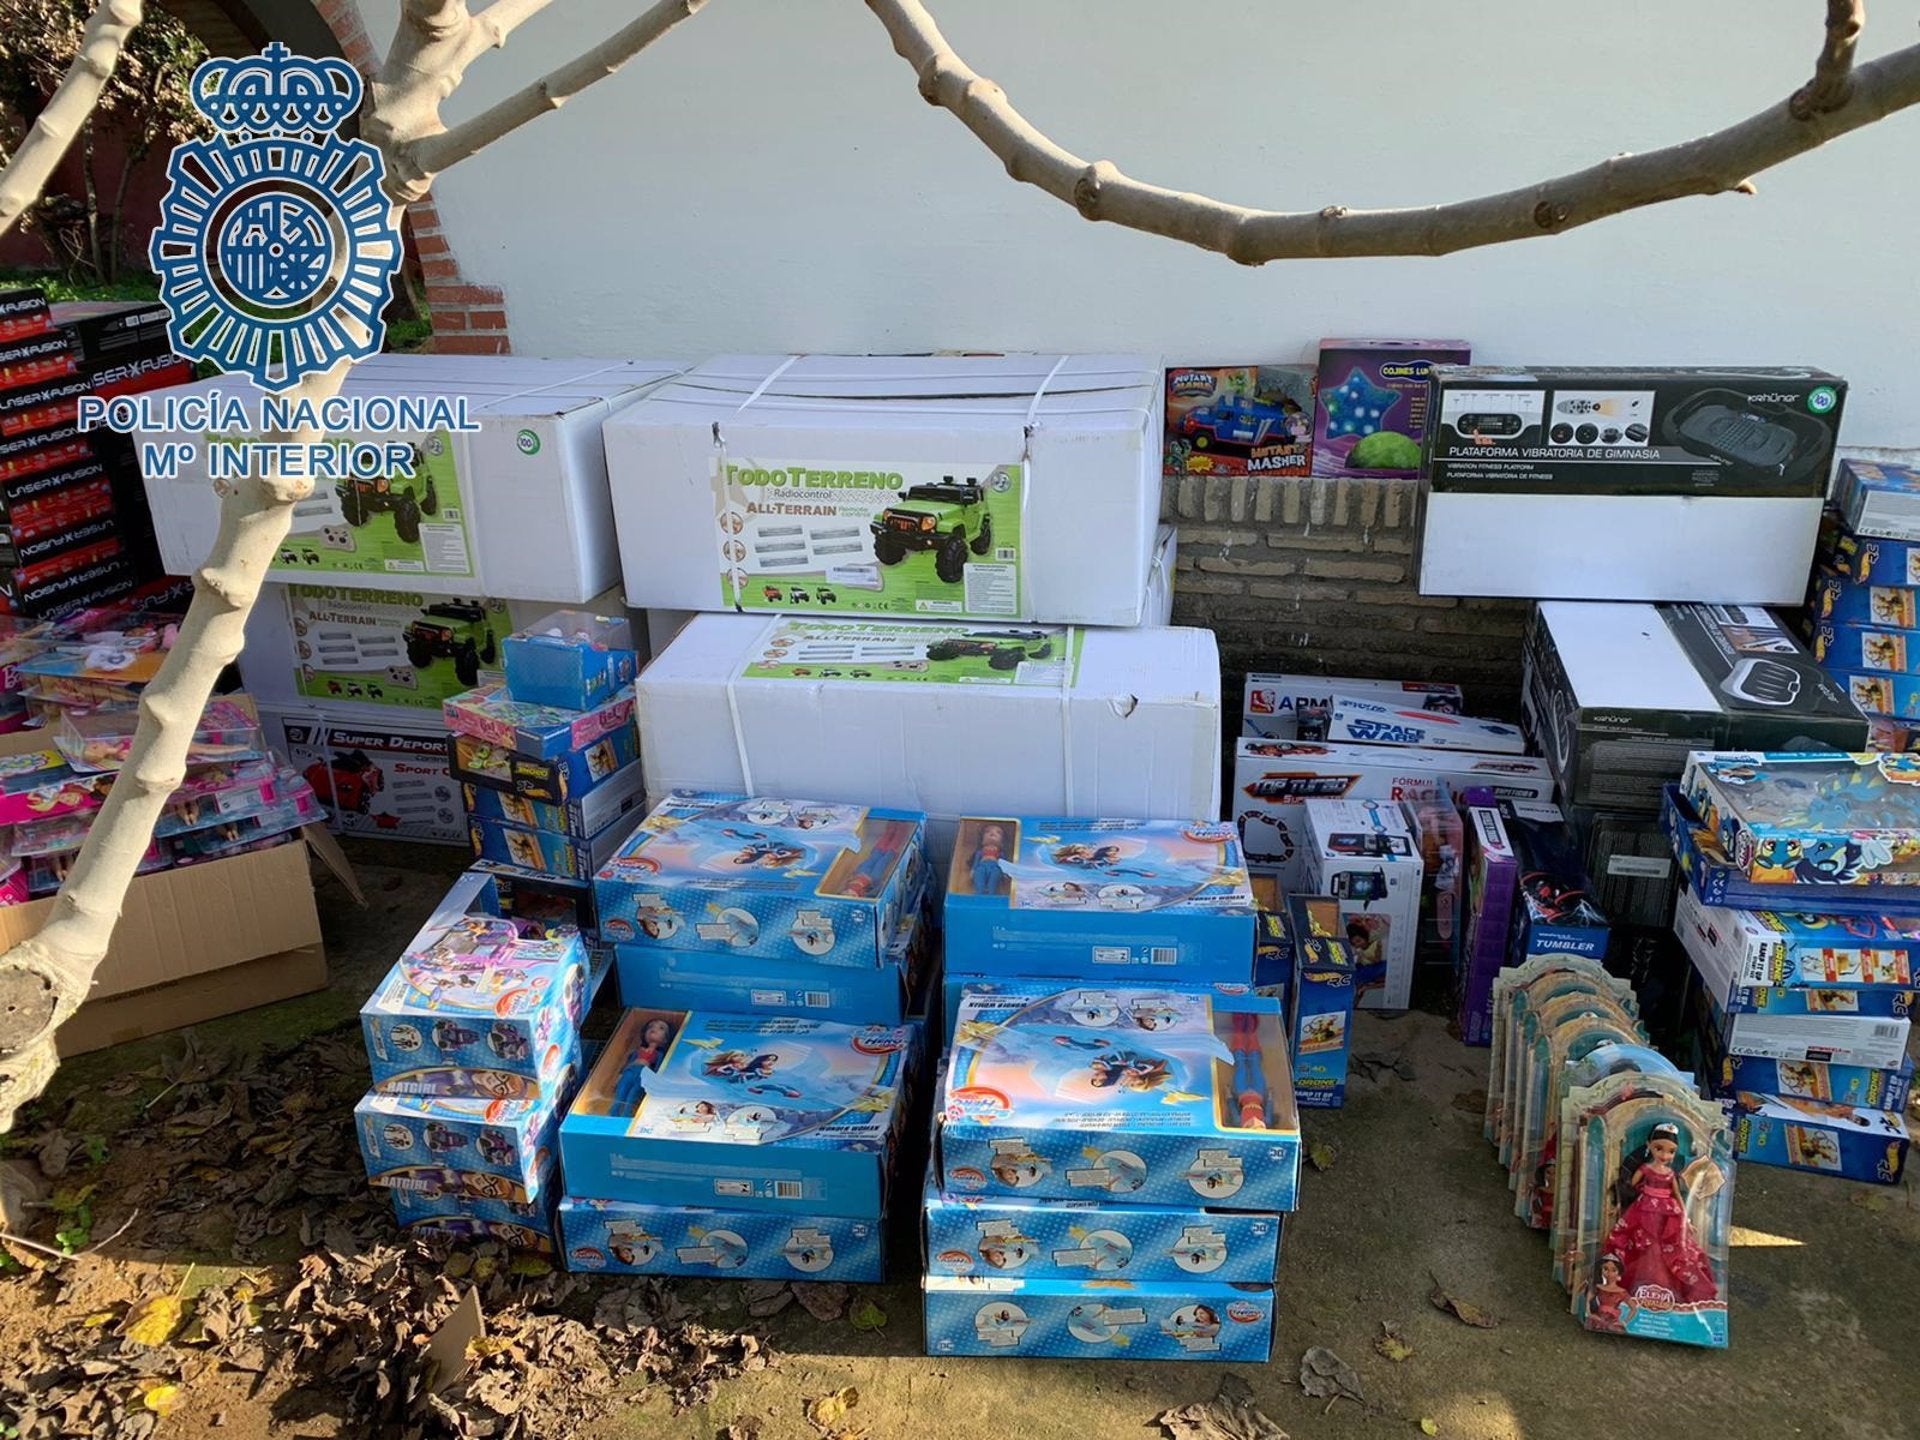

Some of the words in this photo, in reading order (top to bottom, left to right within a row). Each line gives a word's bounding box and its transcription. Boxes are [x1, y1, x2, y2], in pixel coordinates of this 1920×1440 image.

[1449, 447, 1519, 458] PLATAFORMA
[1521, 448, 1585, 459] VIBRATORIA
[1587, 449, 1603, 459] DE
[1605, 449, 1661, 460] GIMNASIA
[1248, 455, 1306, 471] MASHER
[746, 501, 837, 517] ALL-TERRAIN
[333, 731, 384, 746] SUPER
[388, 736, 448, 751] DEPORT
[394, 763, 438, 775] SPORT
[1537, 939, 1595, 951] TUMBLER
[387, 1081, 438, 1095] BATGIRL
